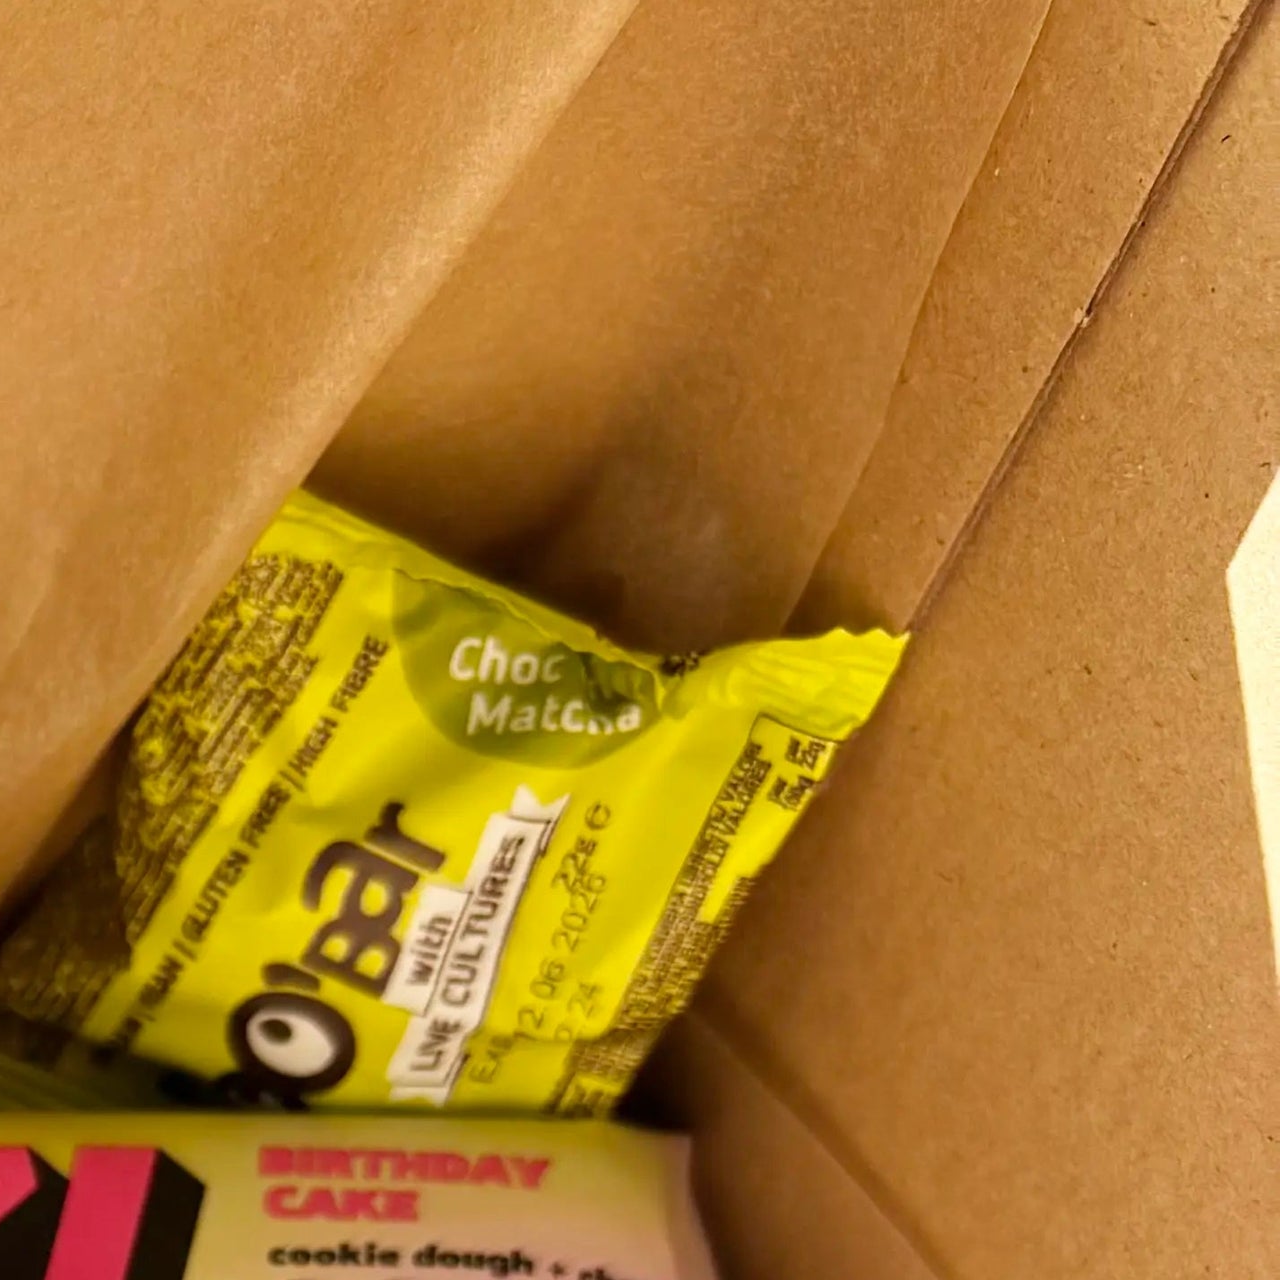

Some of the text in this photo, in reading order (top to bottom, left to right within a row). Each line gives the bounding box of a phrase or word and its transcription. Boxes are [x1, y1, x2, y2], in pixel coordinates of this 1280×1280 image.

[448, 636, 564, 687] Choc
[467, 691, 642, 737] Matcha
[441, 833, 526, 1008] CULTURES
[406, 914, 452, 987] with
[258, 1145, 553, 1189] BIRTHDAY
[262, 1185, 420, 1222] CAKE
[266, 1241, 400, 1268] cookie
[412, 1244, 534, 1277] dough
